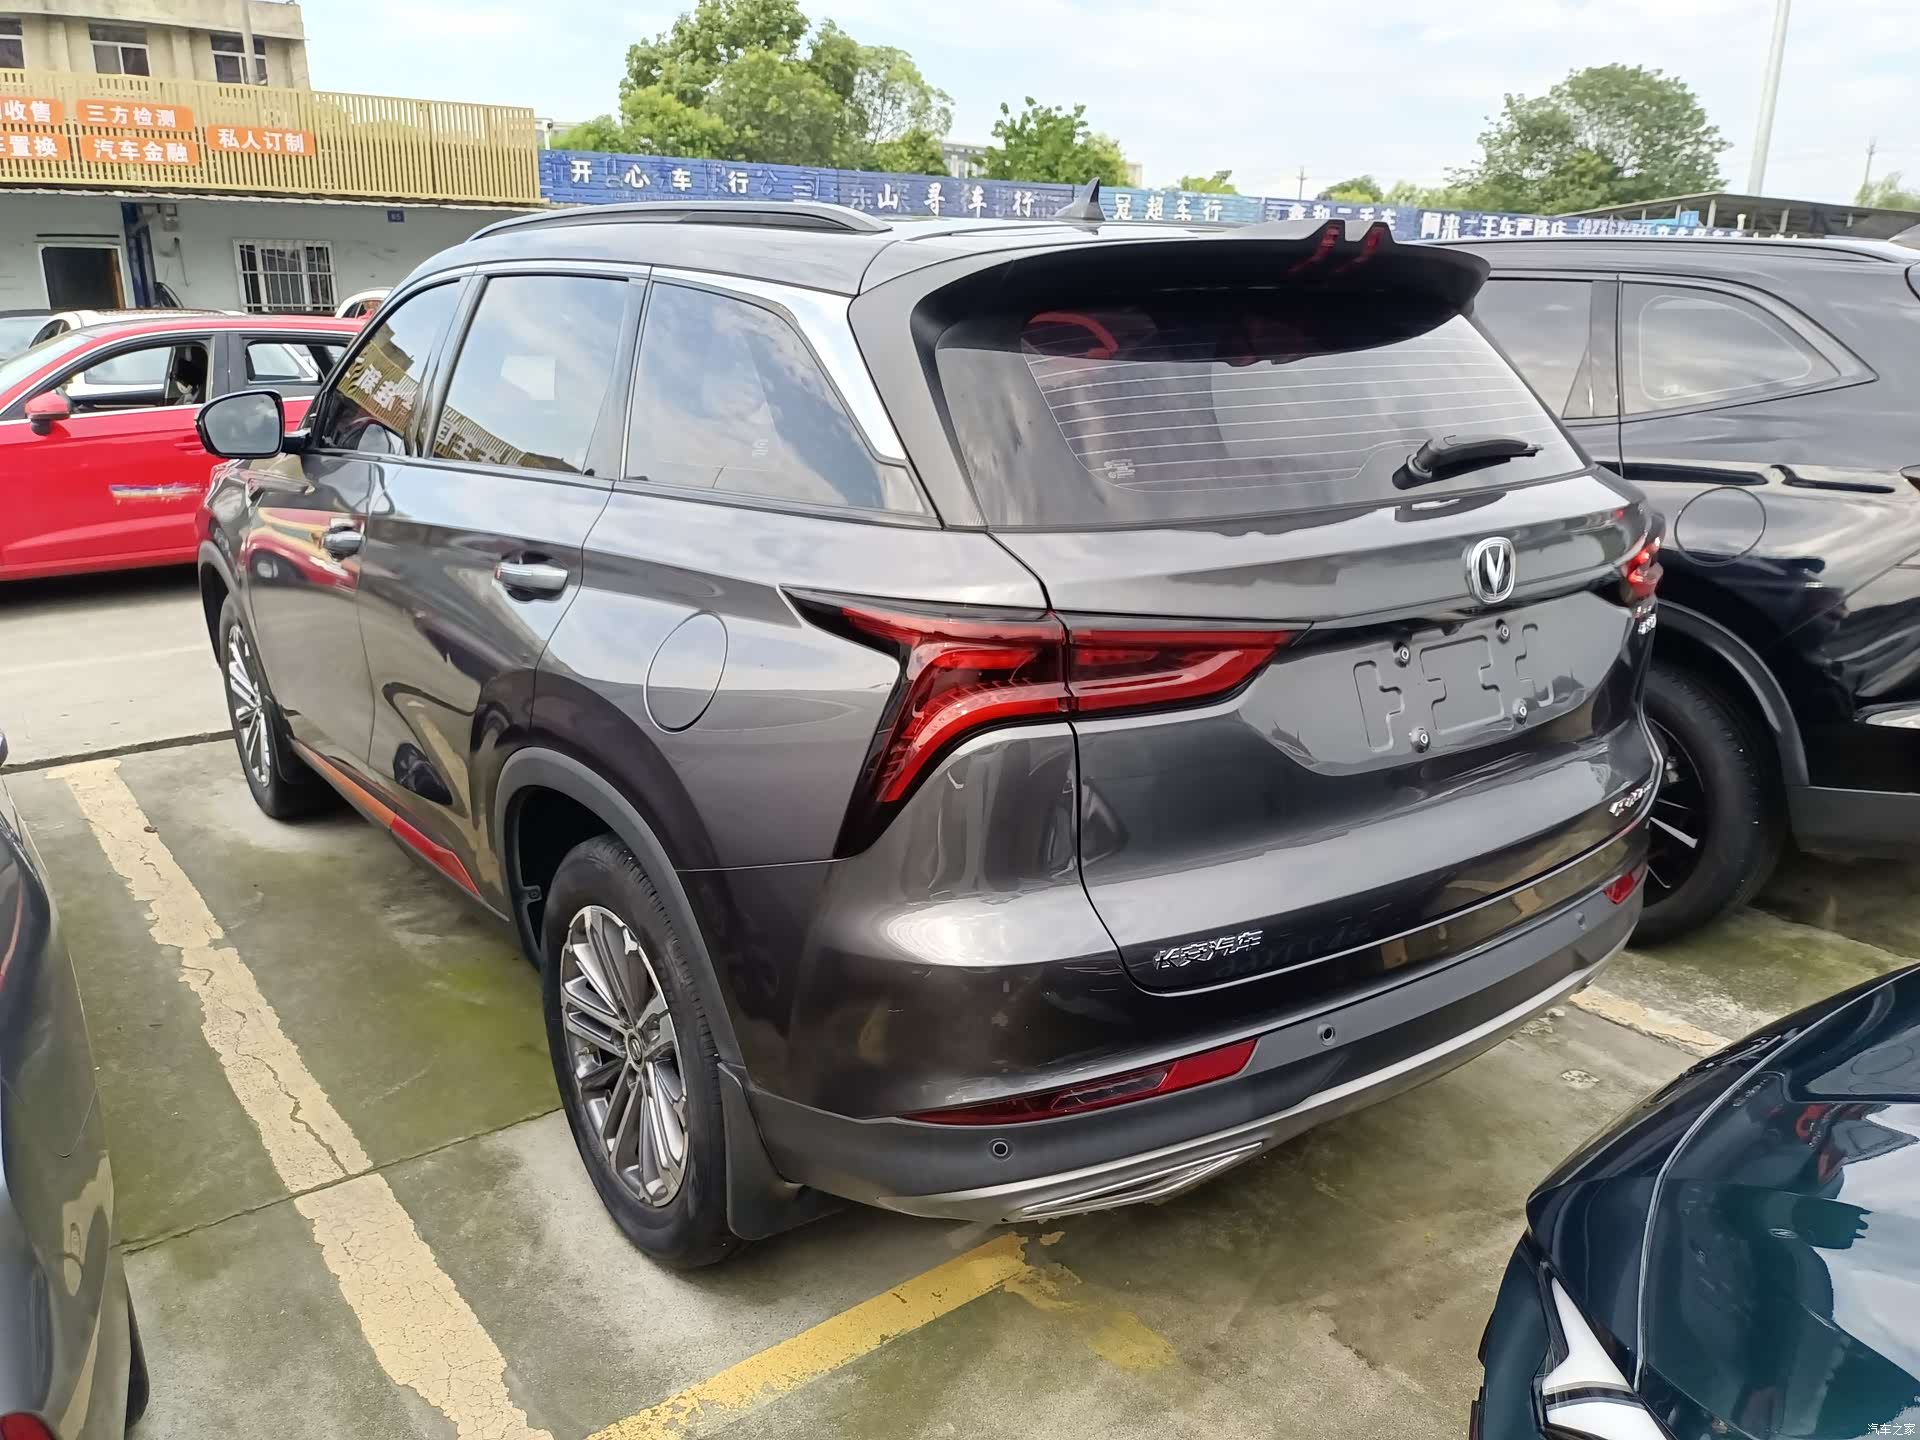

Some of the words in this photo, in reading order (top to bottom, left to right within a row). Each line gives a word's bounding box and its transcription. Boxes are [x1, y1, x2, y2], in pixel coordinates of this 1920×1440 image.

[0, 99, 51, 123] 收售
[87, 104, 177, 128] 三方检测
[0, 135, 58, 157] 置换
[93, 138, 189, 163] 汽车金融
[217, 128, 305, 154] 私人订制
[570, 159, 750, 195] 开心车行
